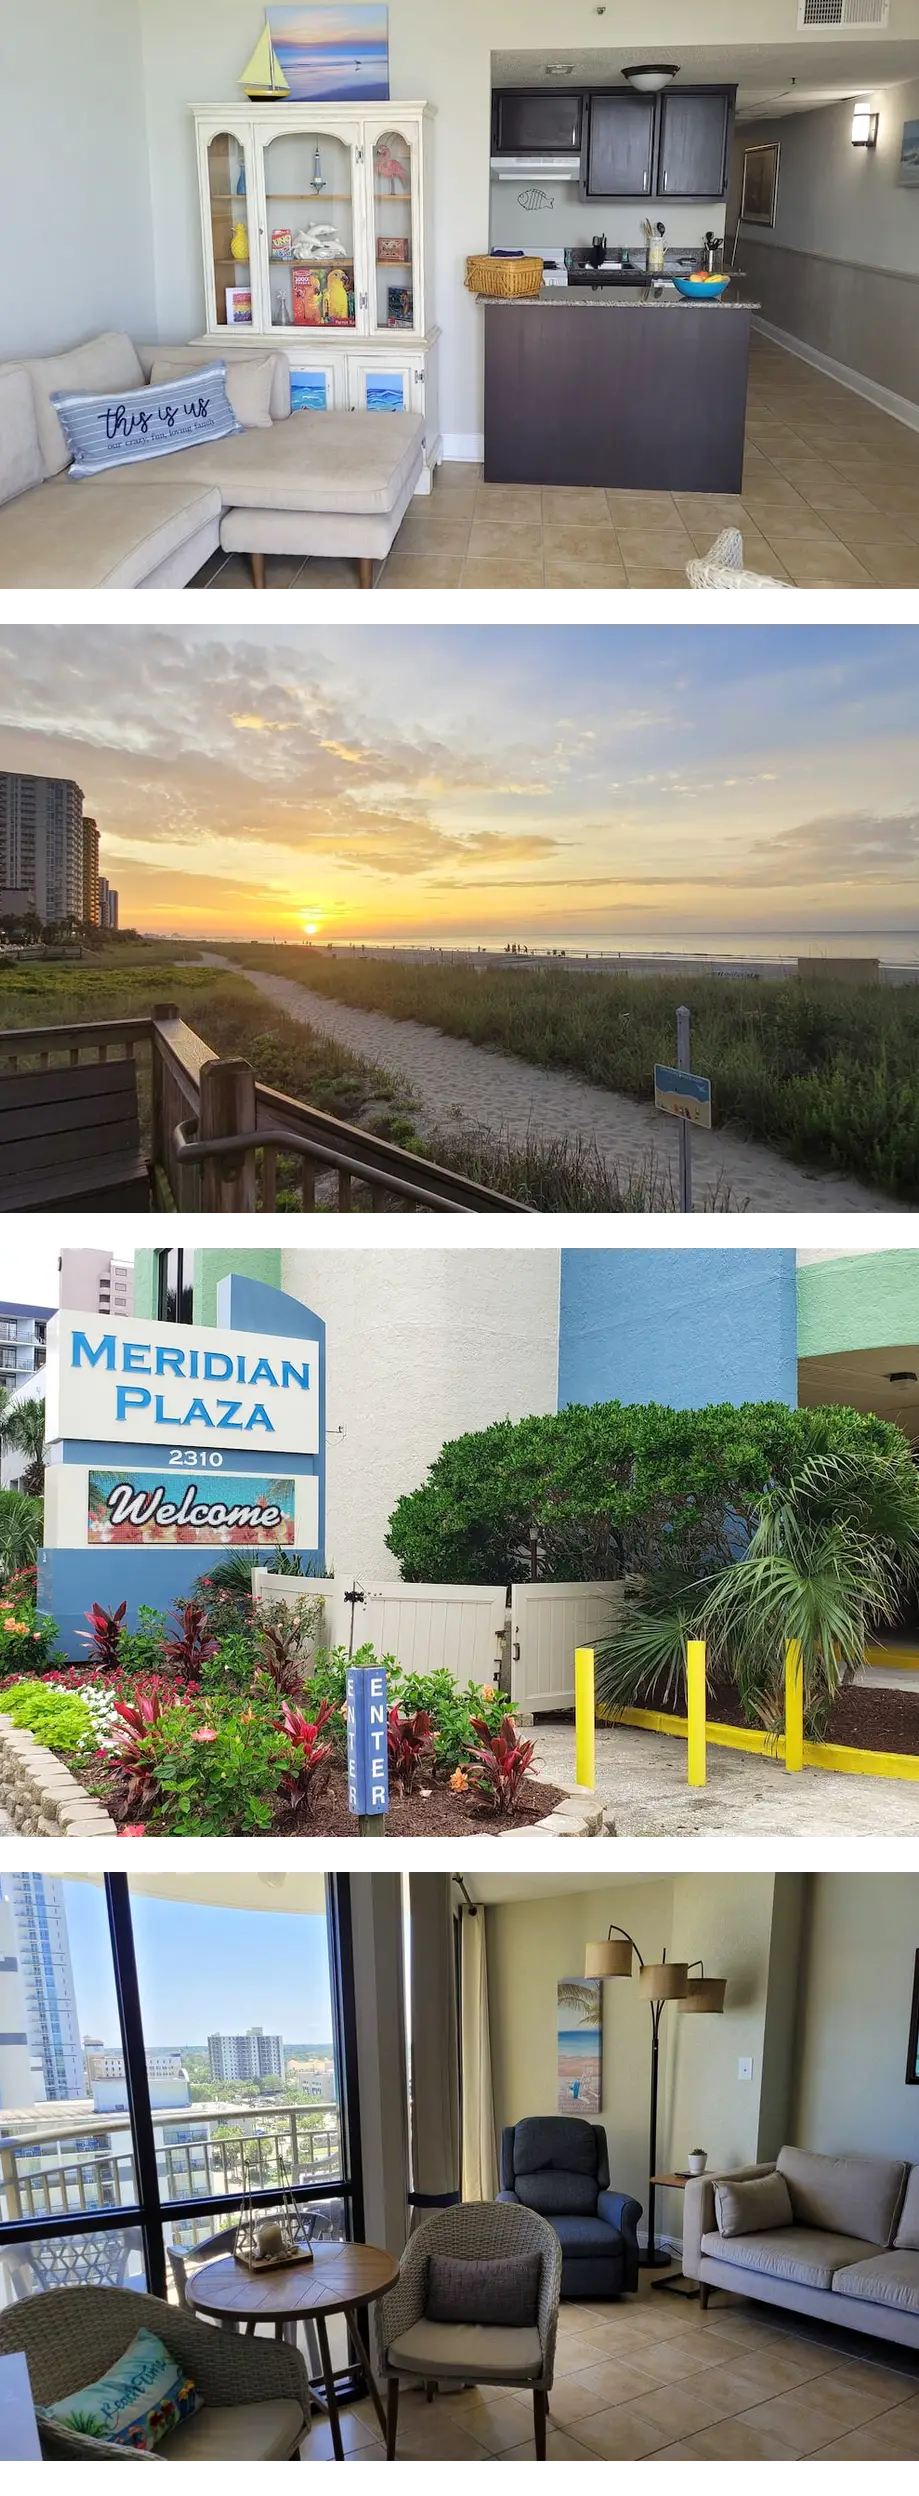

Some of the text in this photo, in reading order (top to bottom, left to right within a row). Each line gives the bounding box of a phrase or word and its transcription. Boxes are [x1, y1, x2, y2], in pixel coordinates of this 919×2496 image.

[98, 398, 210, 439] this is us
[70, 1331, 311, 1390] MERIDIAN
[115, 1385, 276, 1432] PLAZA
[168, 1450, 224, 1468] 2310
[106, 1483, 285, 1528] Welcome
[370, 1678, 386, 1805] ENTER
